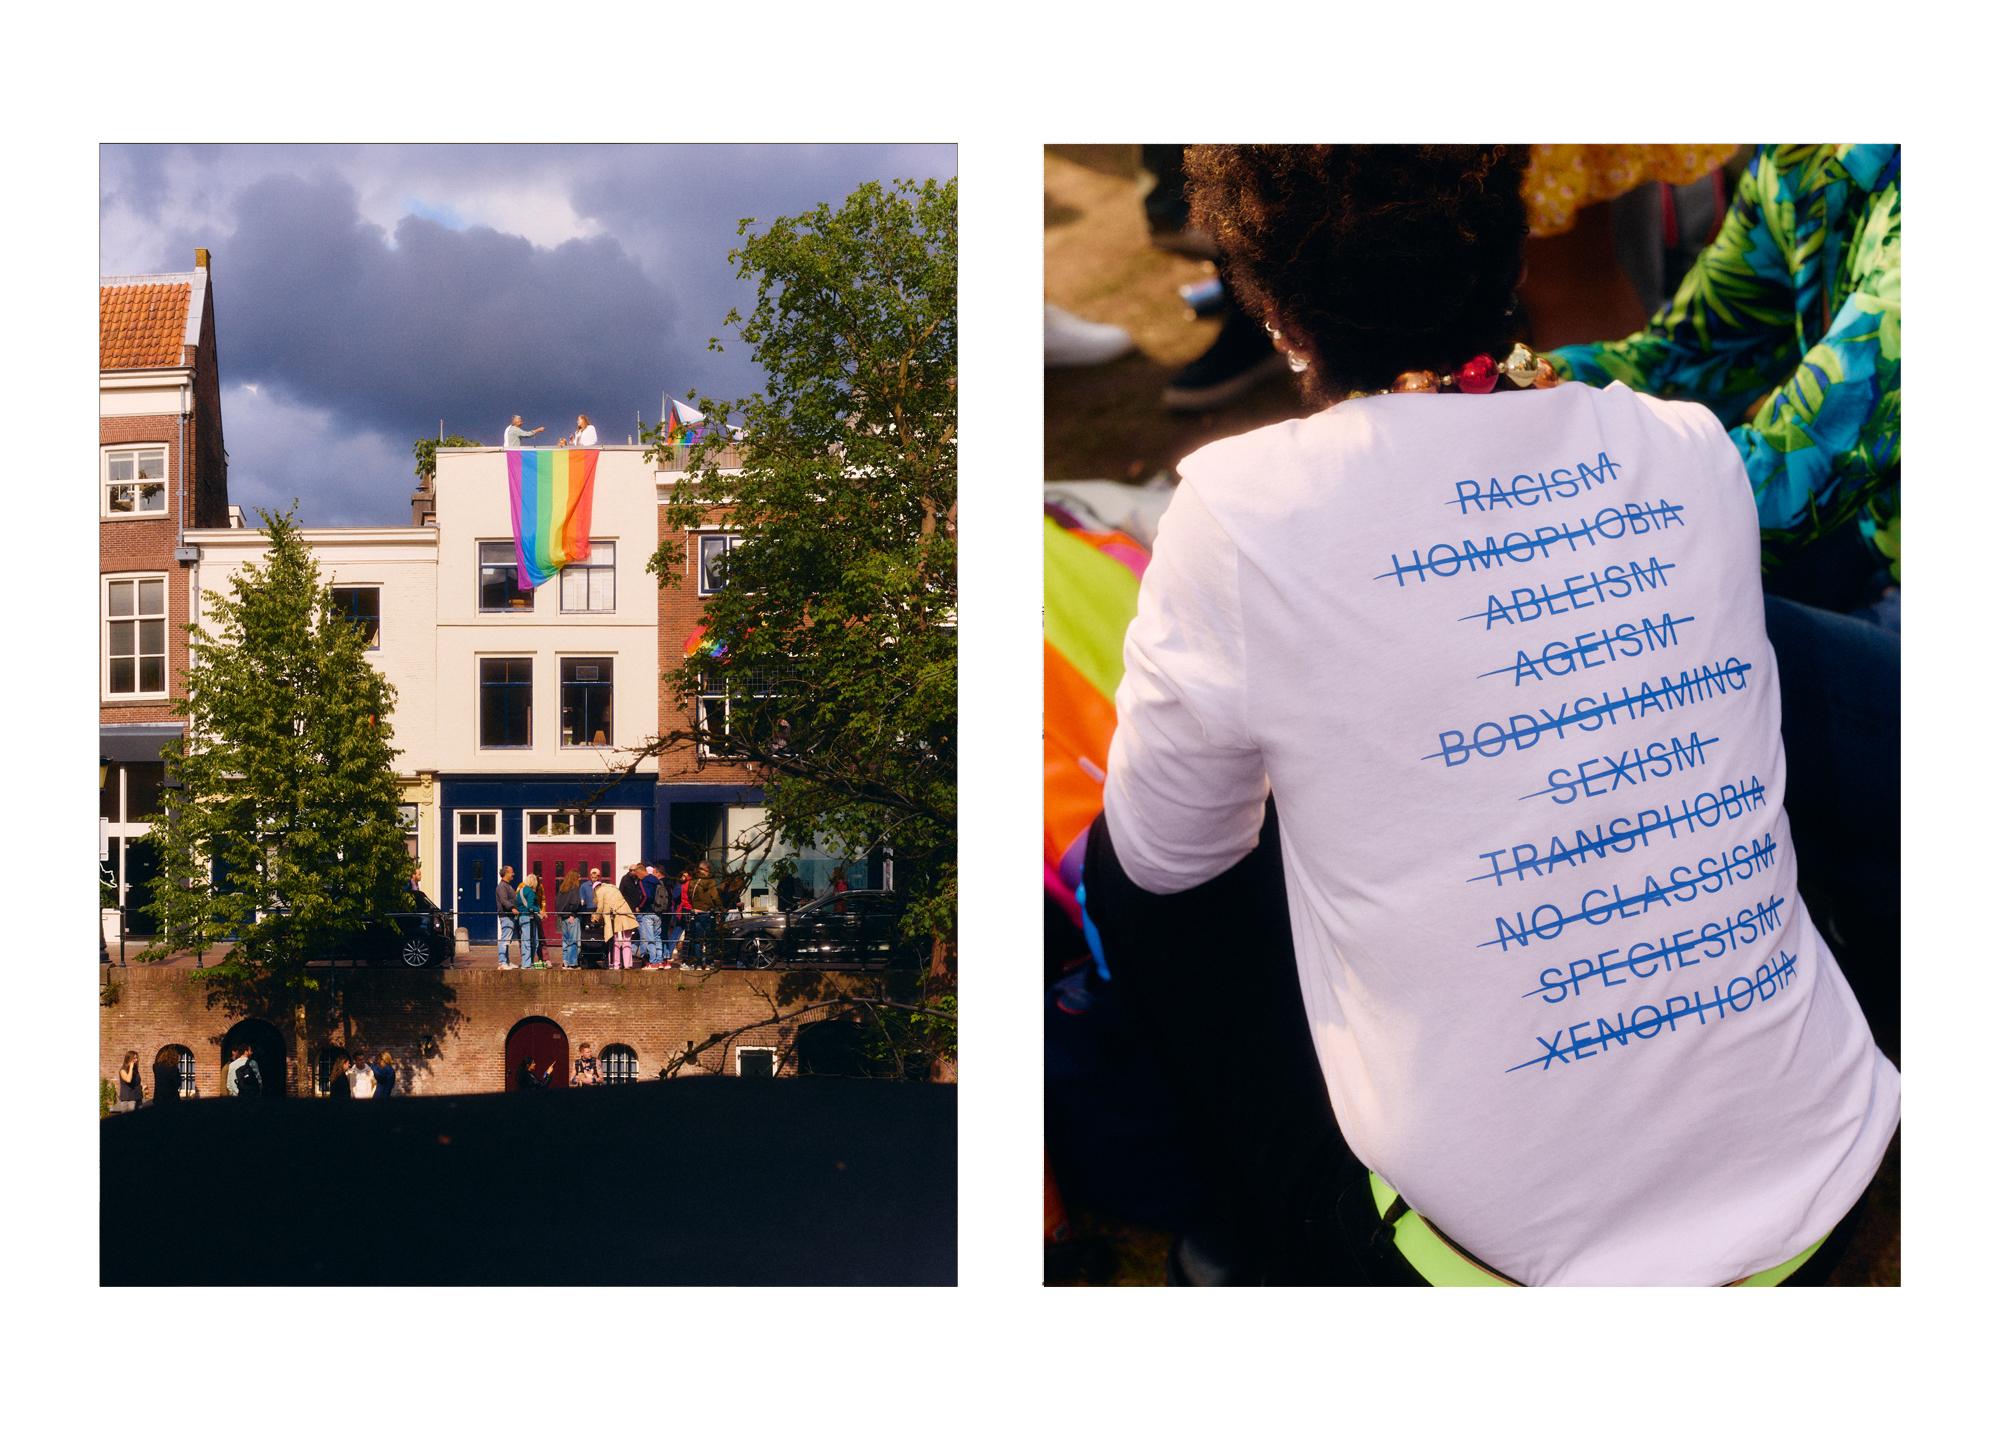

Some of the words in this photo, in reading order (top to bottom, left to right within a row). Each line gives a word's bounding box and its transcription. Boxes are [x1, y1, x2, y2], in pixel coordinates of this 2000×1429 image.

[1455, 452, 1618, 515] RACISM
[1391, 499, 1685, 587] HOMOPHOBIA
[1484, 557, 1668, 630] ABLEISM
[1513, 613, 1678, 686] AGEISM
[1438, 657, 1748, 767] BODYSHAMING
[1548, 732, 1706, 805] SEXISM
[1479, 776, 1766, 886] TRANSPHOBIA
[1495, 904, 1563, 951] NO
[1581, 833, 1775, 926] CLASSISM
[1539, 895, 1782, 1004] SPECIESISM
[1536, 950, 1798, 1070] XENOPHOBIA
